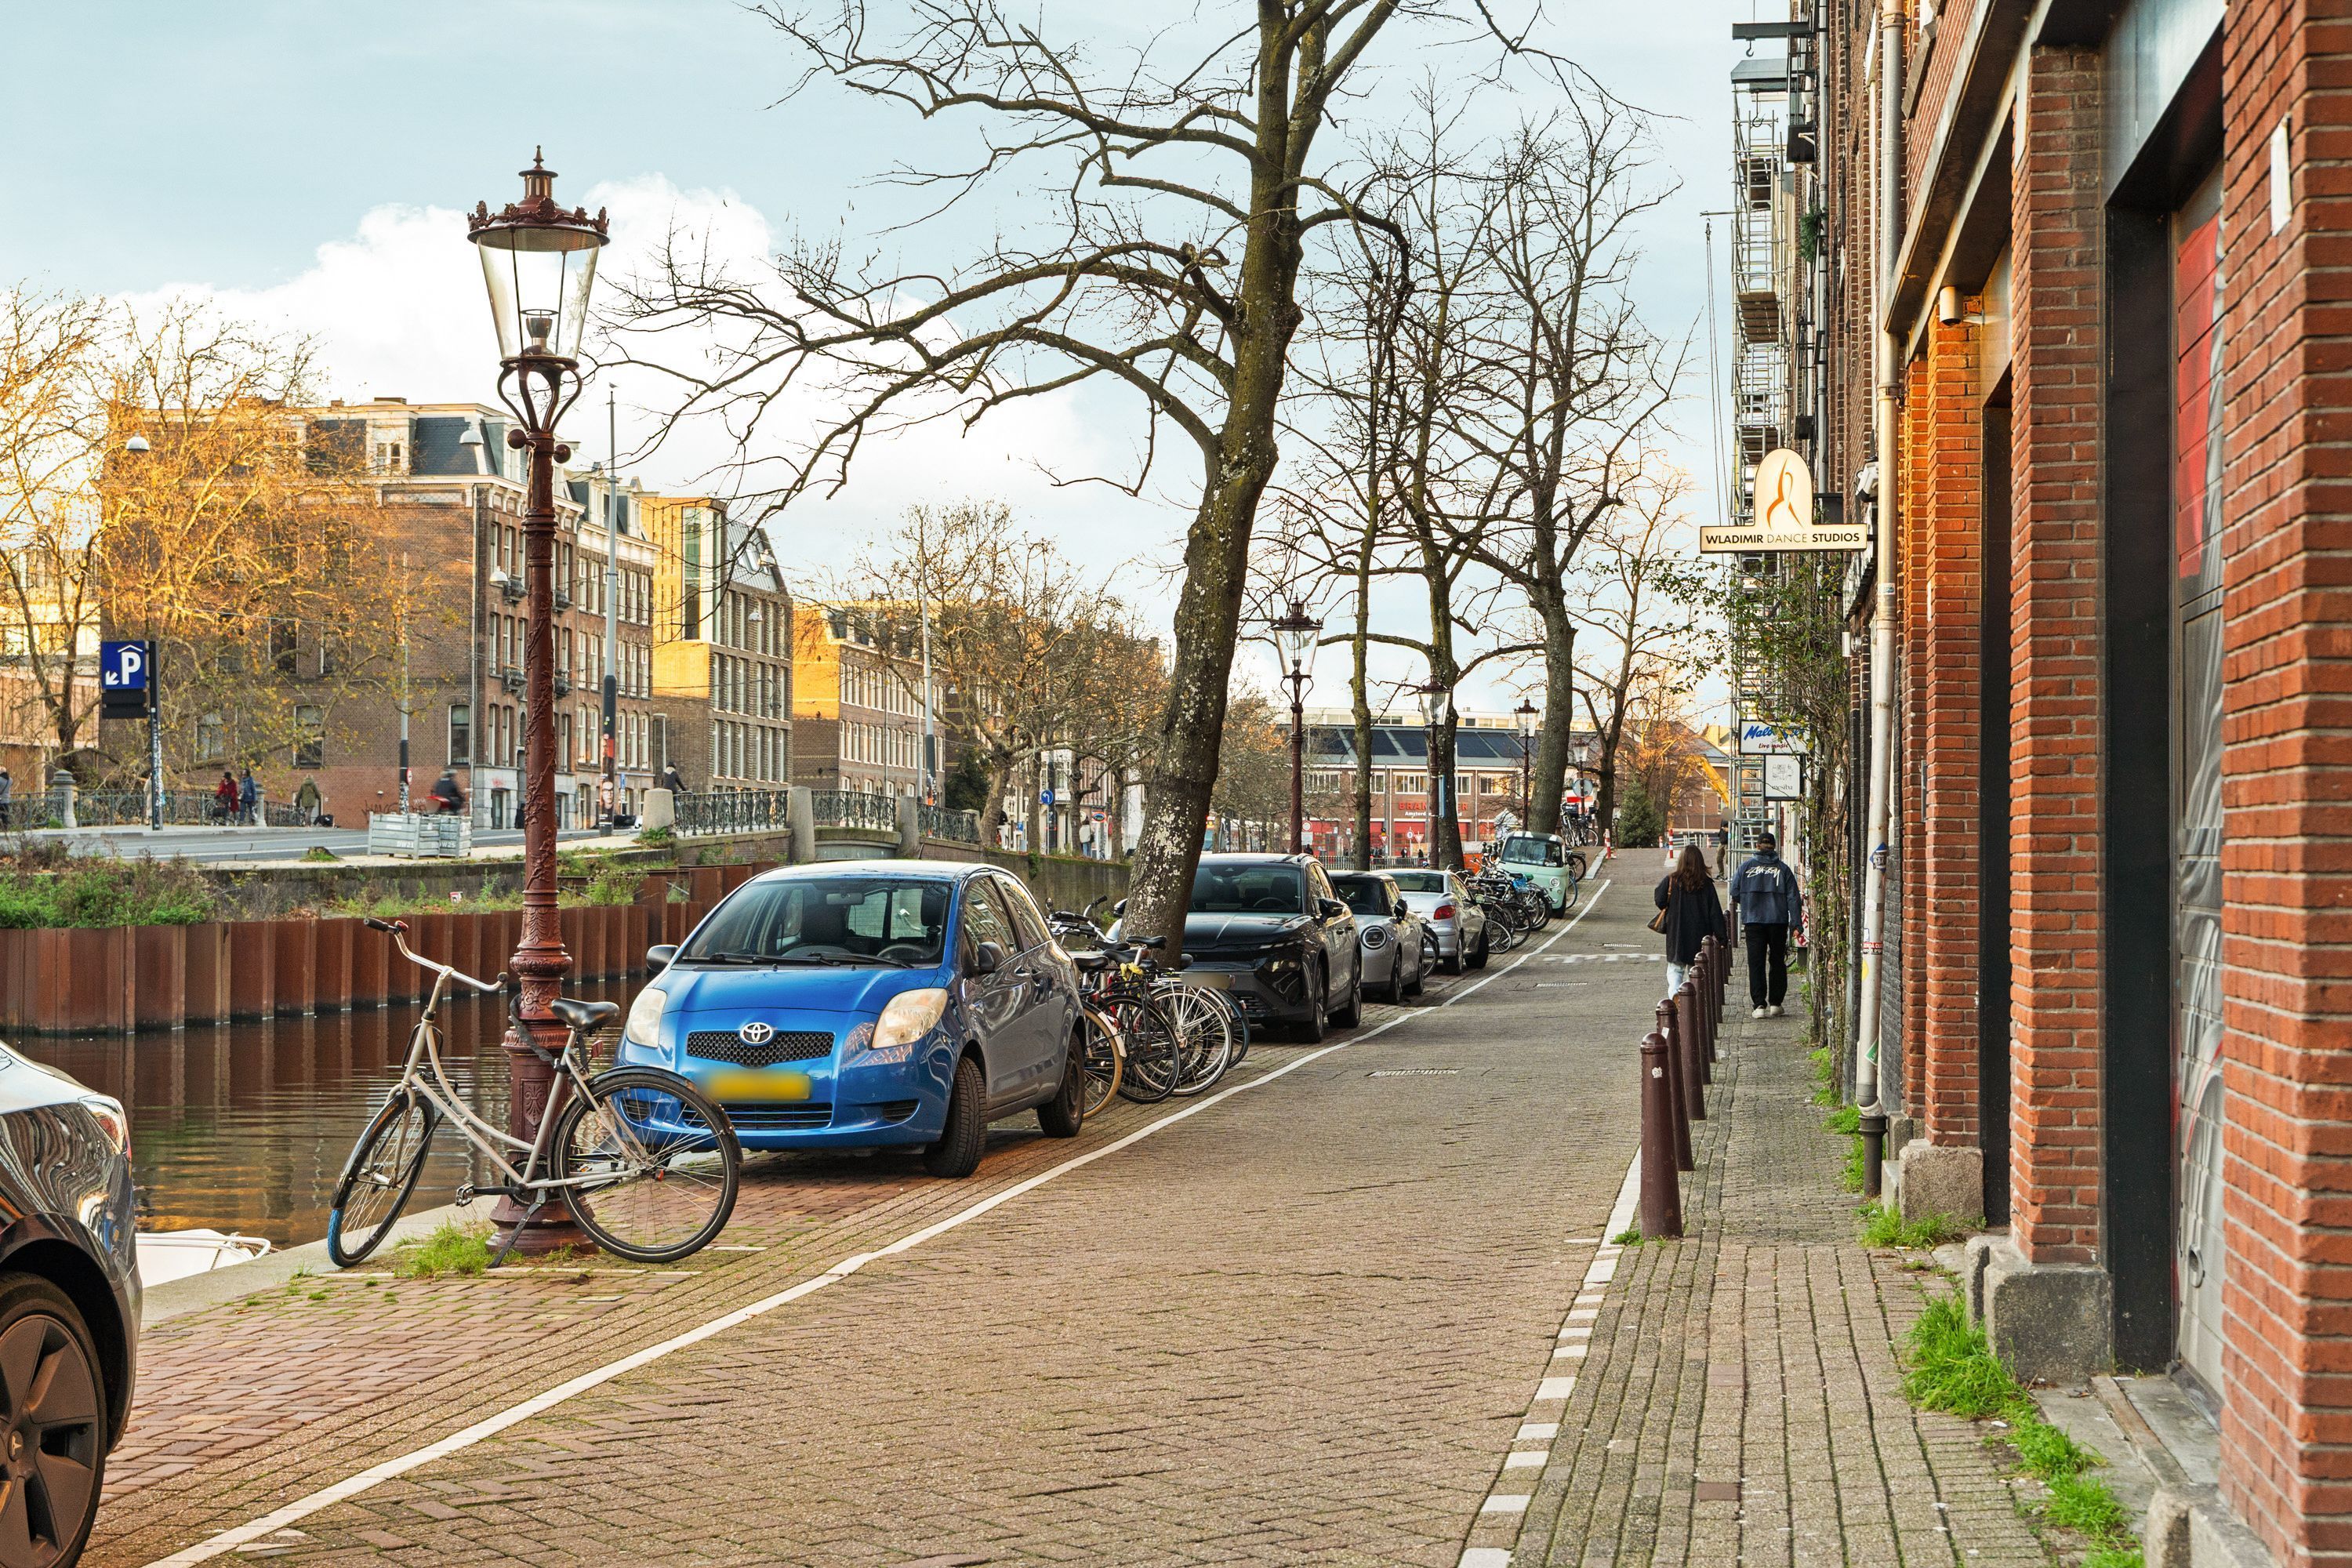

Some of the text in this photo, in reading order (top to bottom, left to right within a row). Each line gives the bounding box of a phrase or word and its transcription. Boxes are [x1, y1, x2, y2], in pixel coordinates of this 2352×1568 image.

[1706, 533, 1860, 544] WLADIMIR DANCE STUDIOS
[122, 652, 141, 684] P
